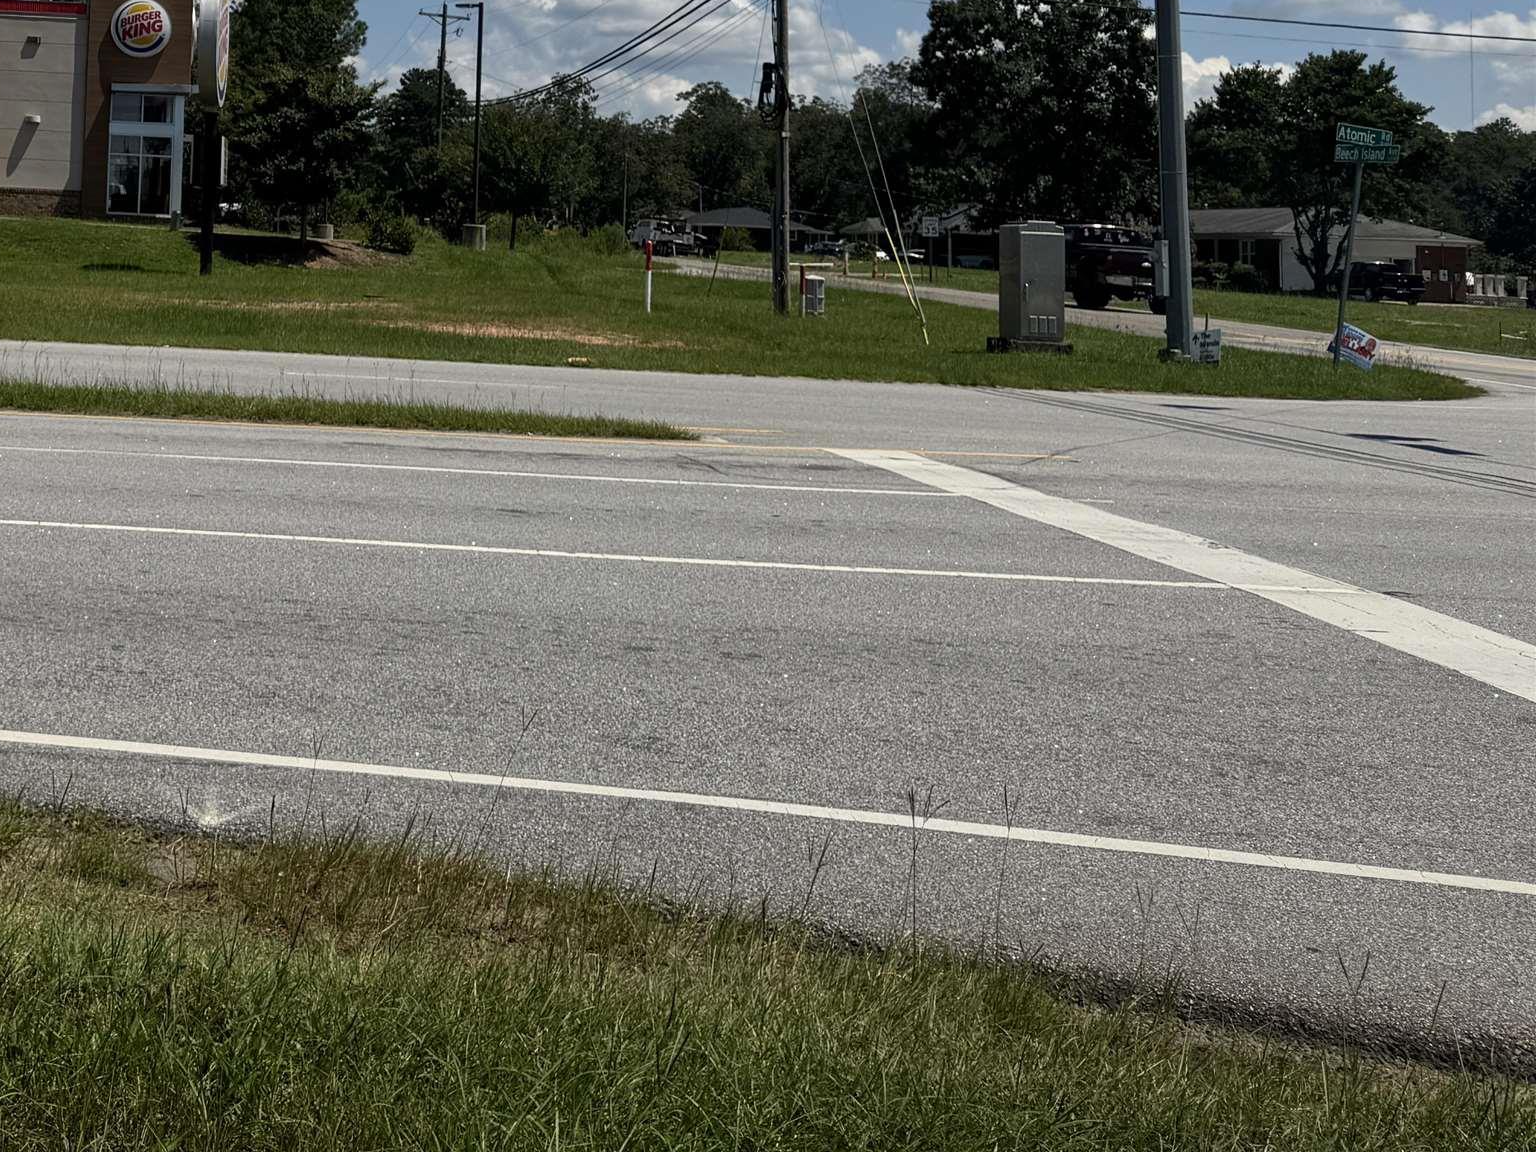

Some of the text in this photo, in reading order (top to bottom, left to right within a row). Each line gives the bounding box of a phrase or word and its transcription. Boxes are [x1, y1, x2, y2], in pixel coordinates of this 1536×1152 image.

[120, 10, 162, 28] BURGER
[121, 19, 163, 41] KING
[1338, 126, 1376, 144] Atomic
[1335, 147, 1359, 160] Beech
[1361, 147, 1386, 160] Island
